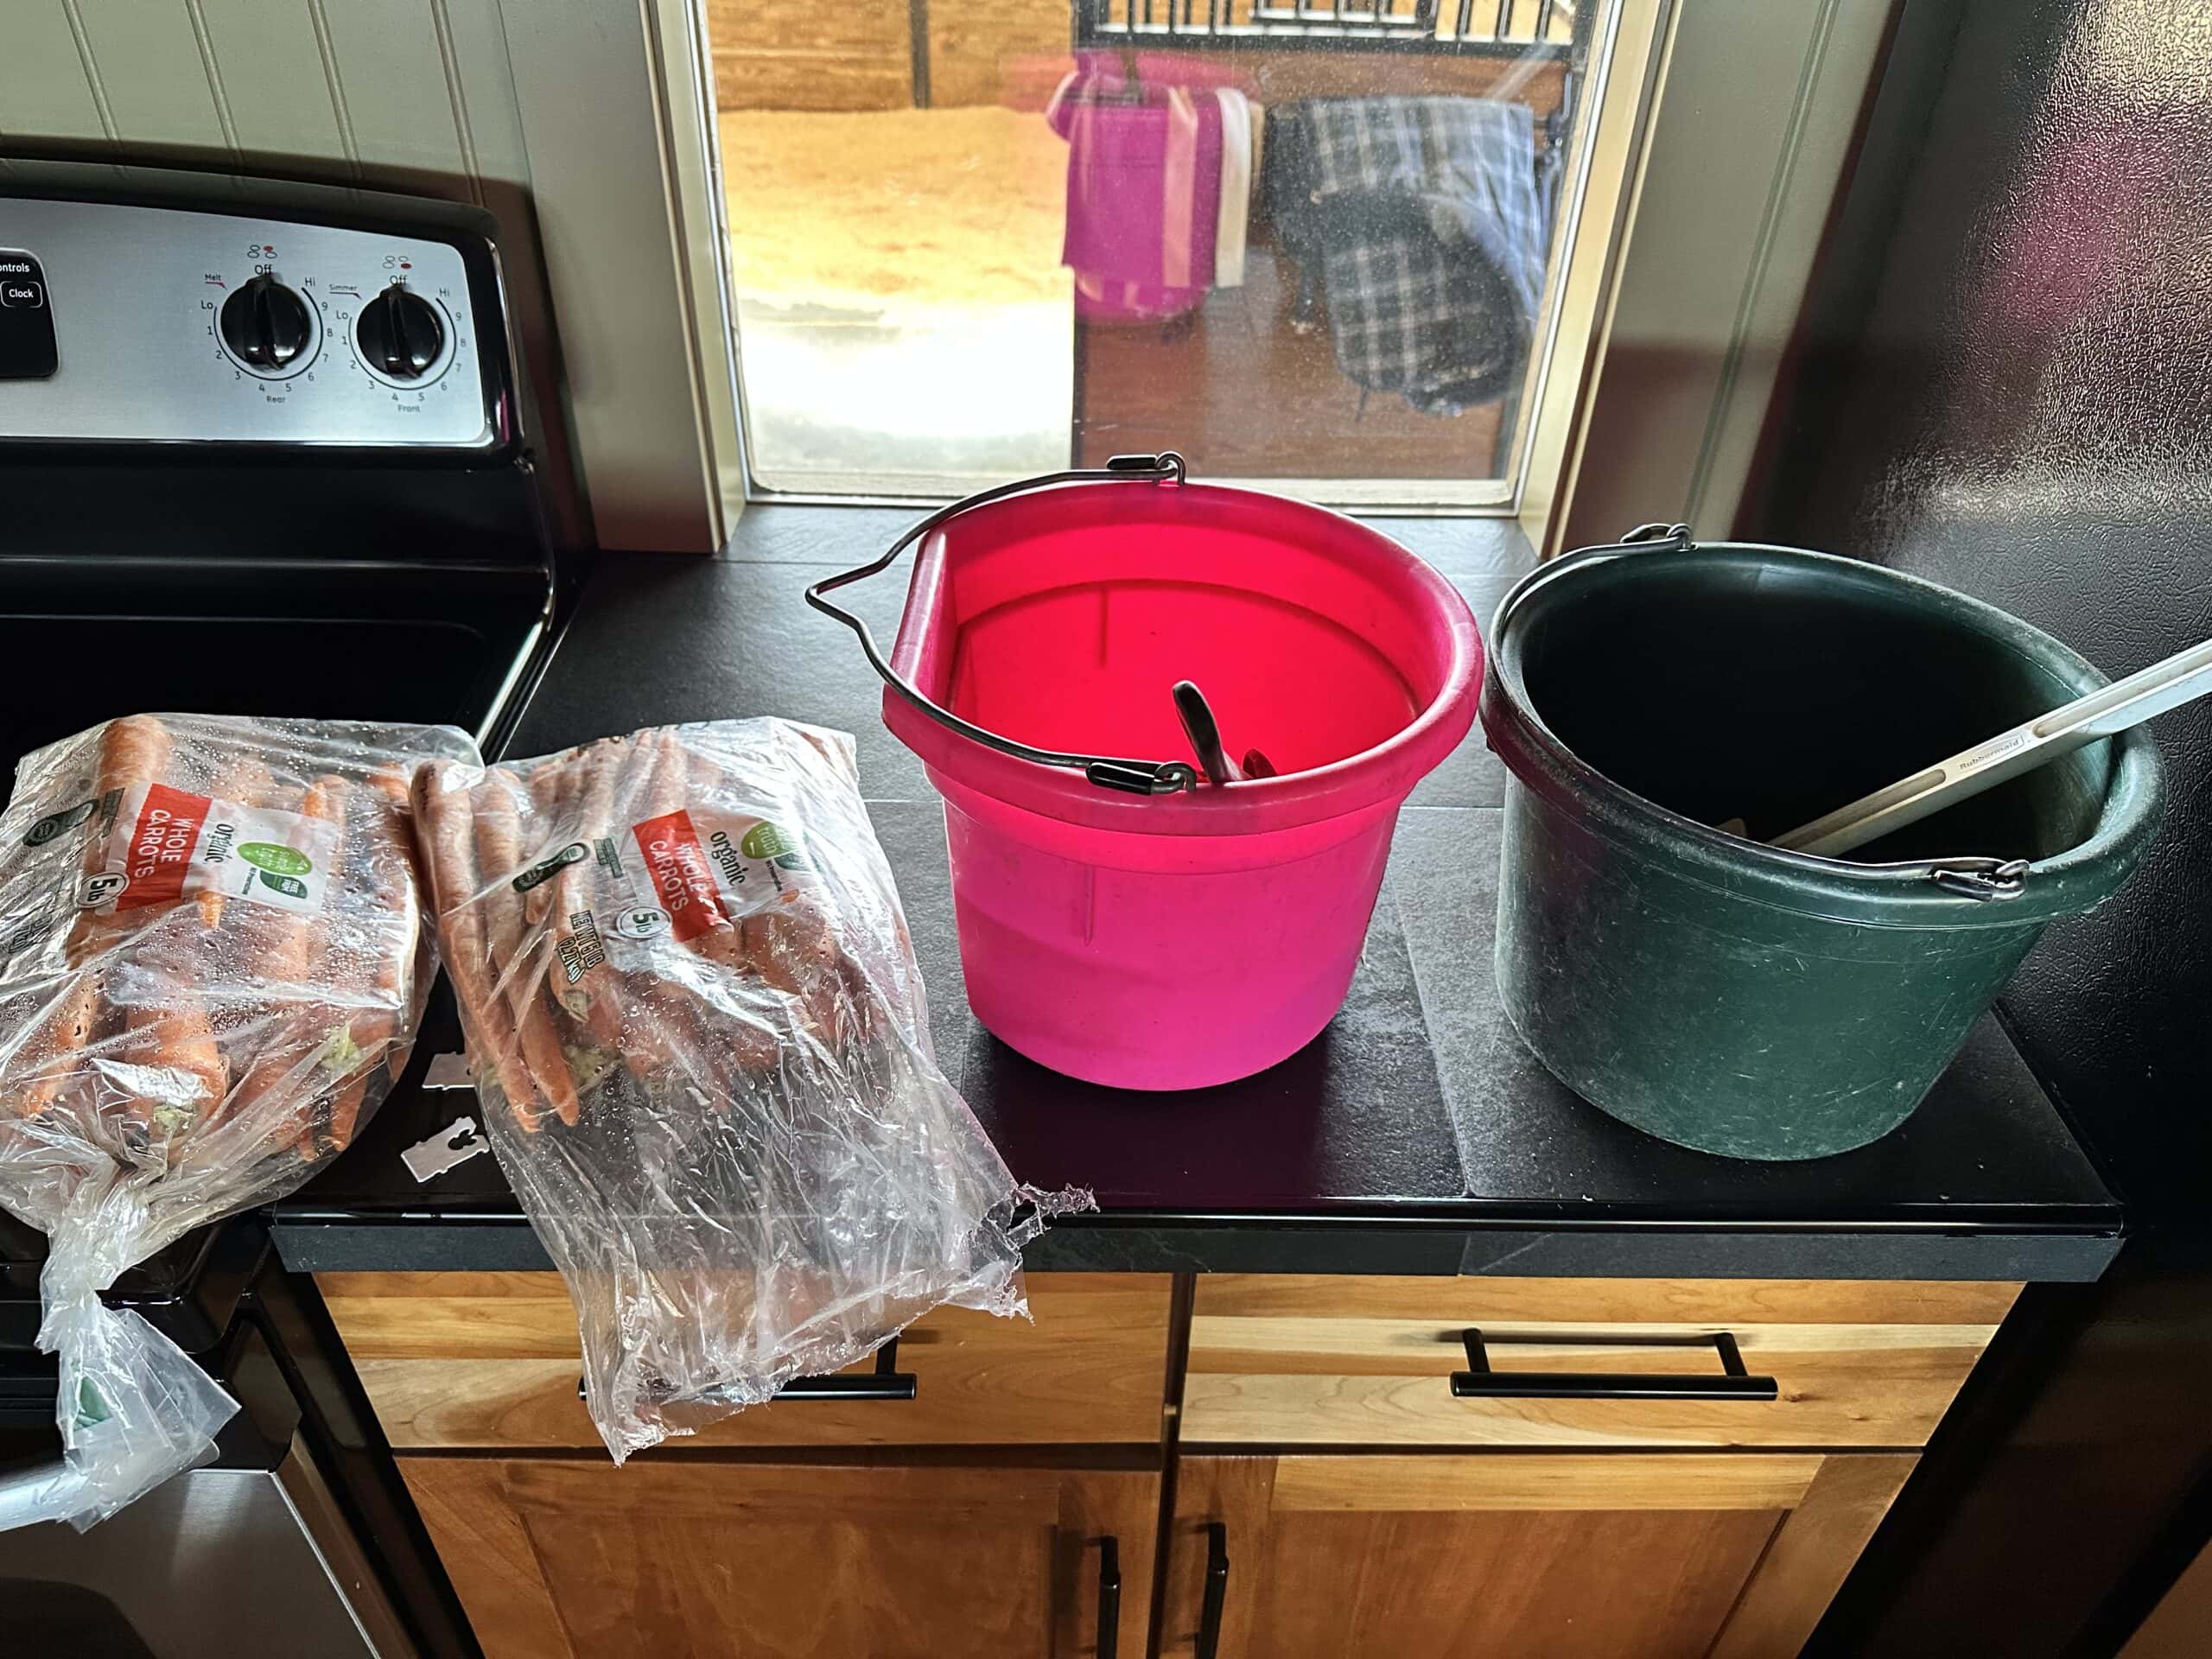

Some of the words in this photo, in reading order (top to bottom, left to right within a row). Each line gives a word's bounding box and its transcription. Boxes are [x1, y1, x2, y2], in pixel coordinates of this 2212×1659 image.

[254, 264, 273, 276] Off
[205, 273, 222, 282] Melt
[304, 277, 316, 287] Hi
[389, 275, 408, 285] Off
[9, 288, 34, 298] Clock
[439, 288, 450, 297] Hi
[200, 300, 214, 310] Lo
[321, 302, 328, 311] 9
[335, 310, 349, 320] Lo
[454, 312, 462, 321] 9
[207, 326, 213, 335] 1
[327, 327, 334, 337] 8
[341, 335, 348, 346] 1
[216, 350, 222, 359] 2
[322, 353, 328, 363] 7
[349, 359, 357, 369] 2
[234, 371, 241, 380] 3
[308, 372, 315, 381] 6
[258, 383, 265, 392] 4
[285, 383, 292, 392] 5
[368, 380, 375, 390] 3
[440, 381, 448, 391] 6
[266, 395, 286, 404] Rear
[391, 392, 398, 402] 4
[417, 391, 425, 401] 5
[397, 404, 421, 413] Front
[1959, 739, 2020, 769] Rubbermaid
[133, 809, 172, 879] CARROTS
[161, 817, 194, 863] WHOLE
[203, 823, 235, 863] organic
[756, 826, 778, 854] truth
[709, 830, 750, 887] organic
[673, 842, 712, 893] WHOLE
[649, 840, 690, 912] CARROTS
